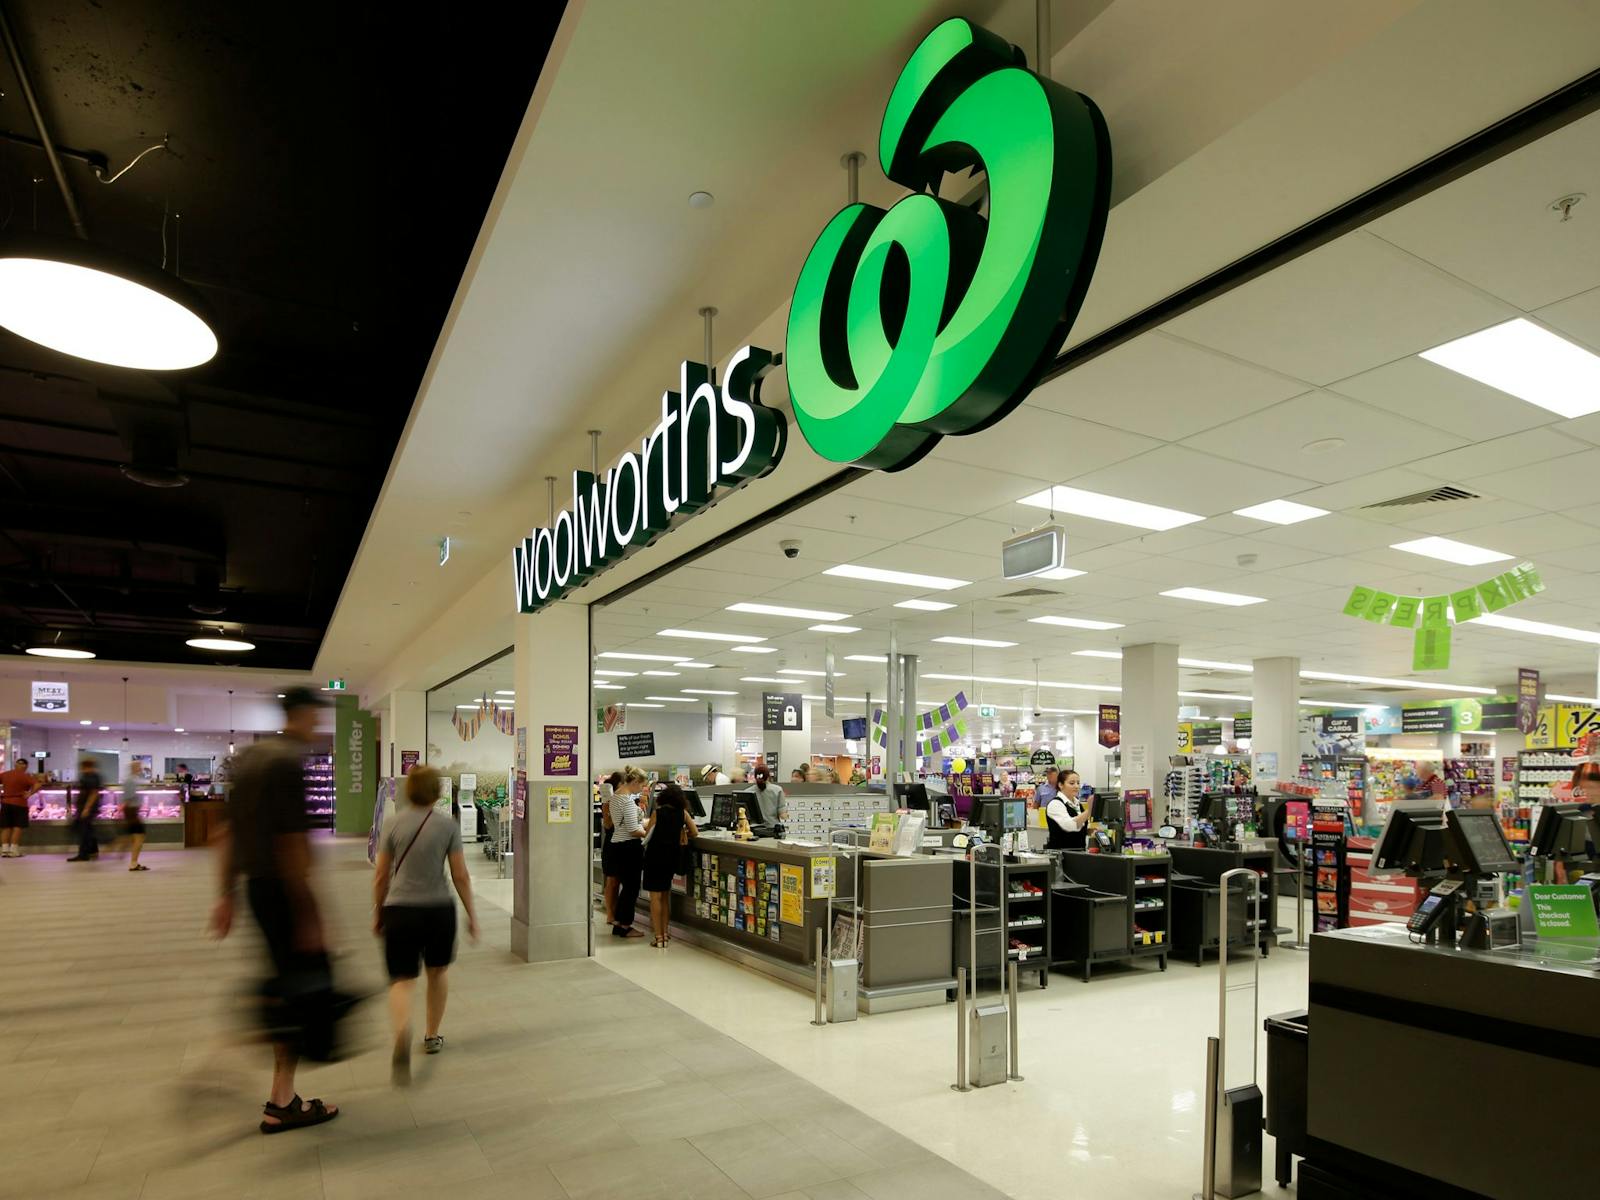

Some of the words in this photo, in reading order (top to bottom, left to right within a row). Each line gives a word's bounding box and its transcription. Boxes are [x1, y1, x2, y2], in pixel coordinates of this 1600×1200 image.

[513, 345, 757, 614] woolworths
[1460, 711, 1473, 725] 3
[349, 720, 363, 793] butcher
[1536, 903, 1552, 911] This
